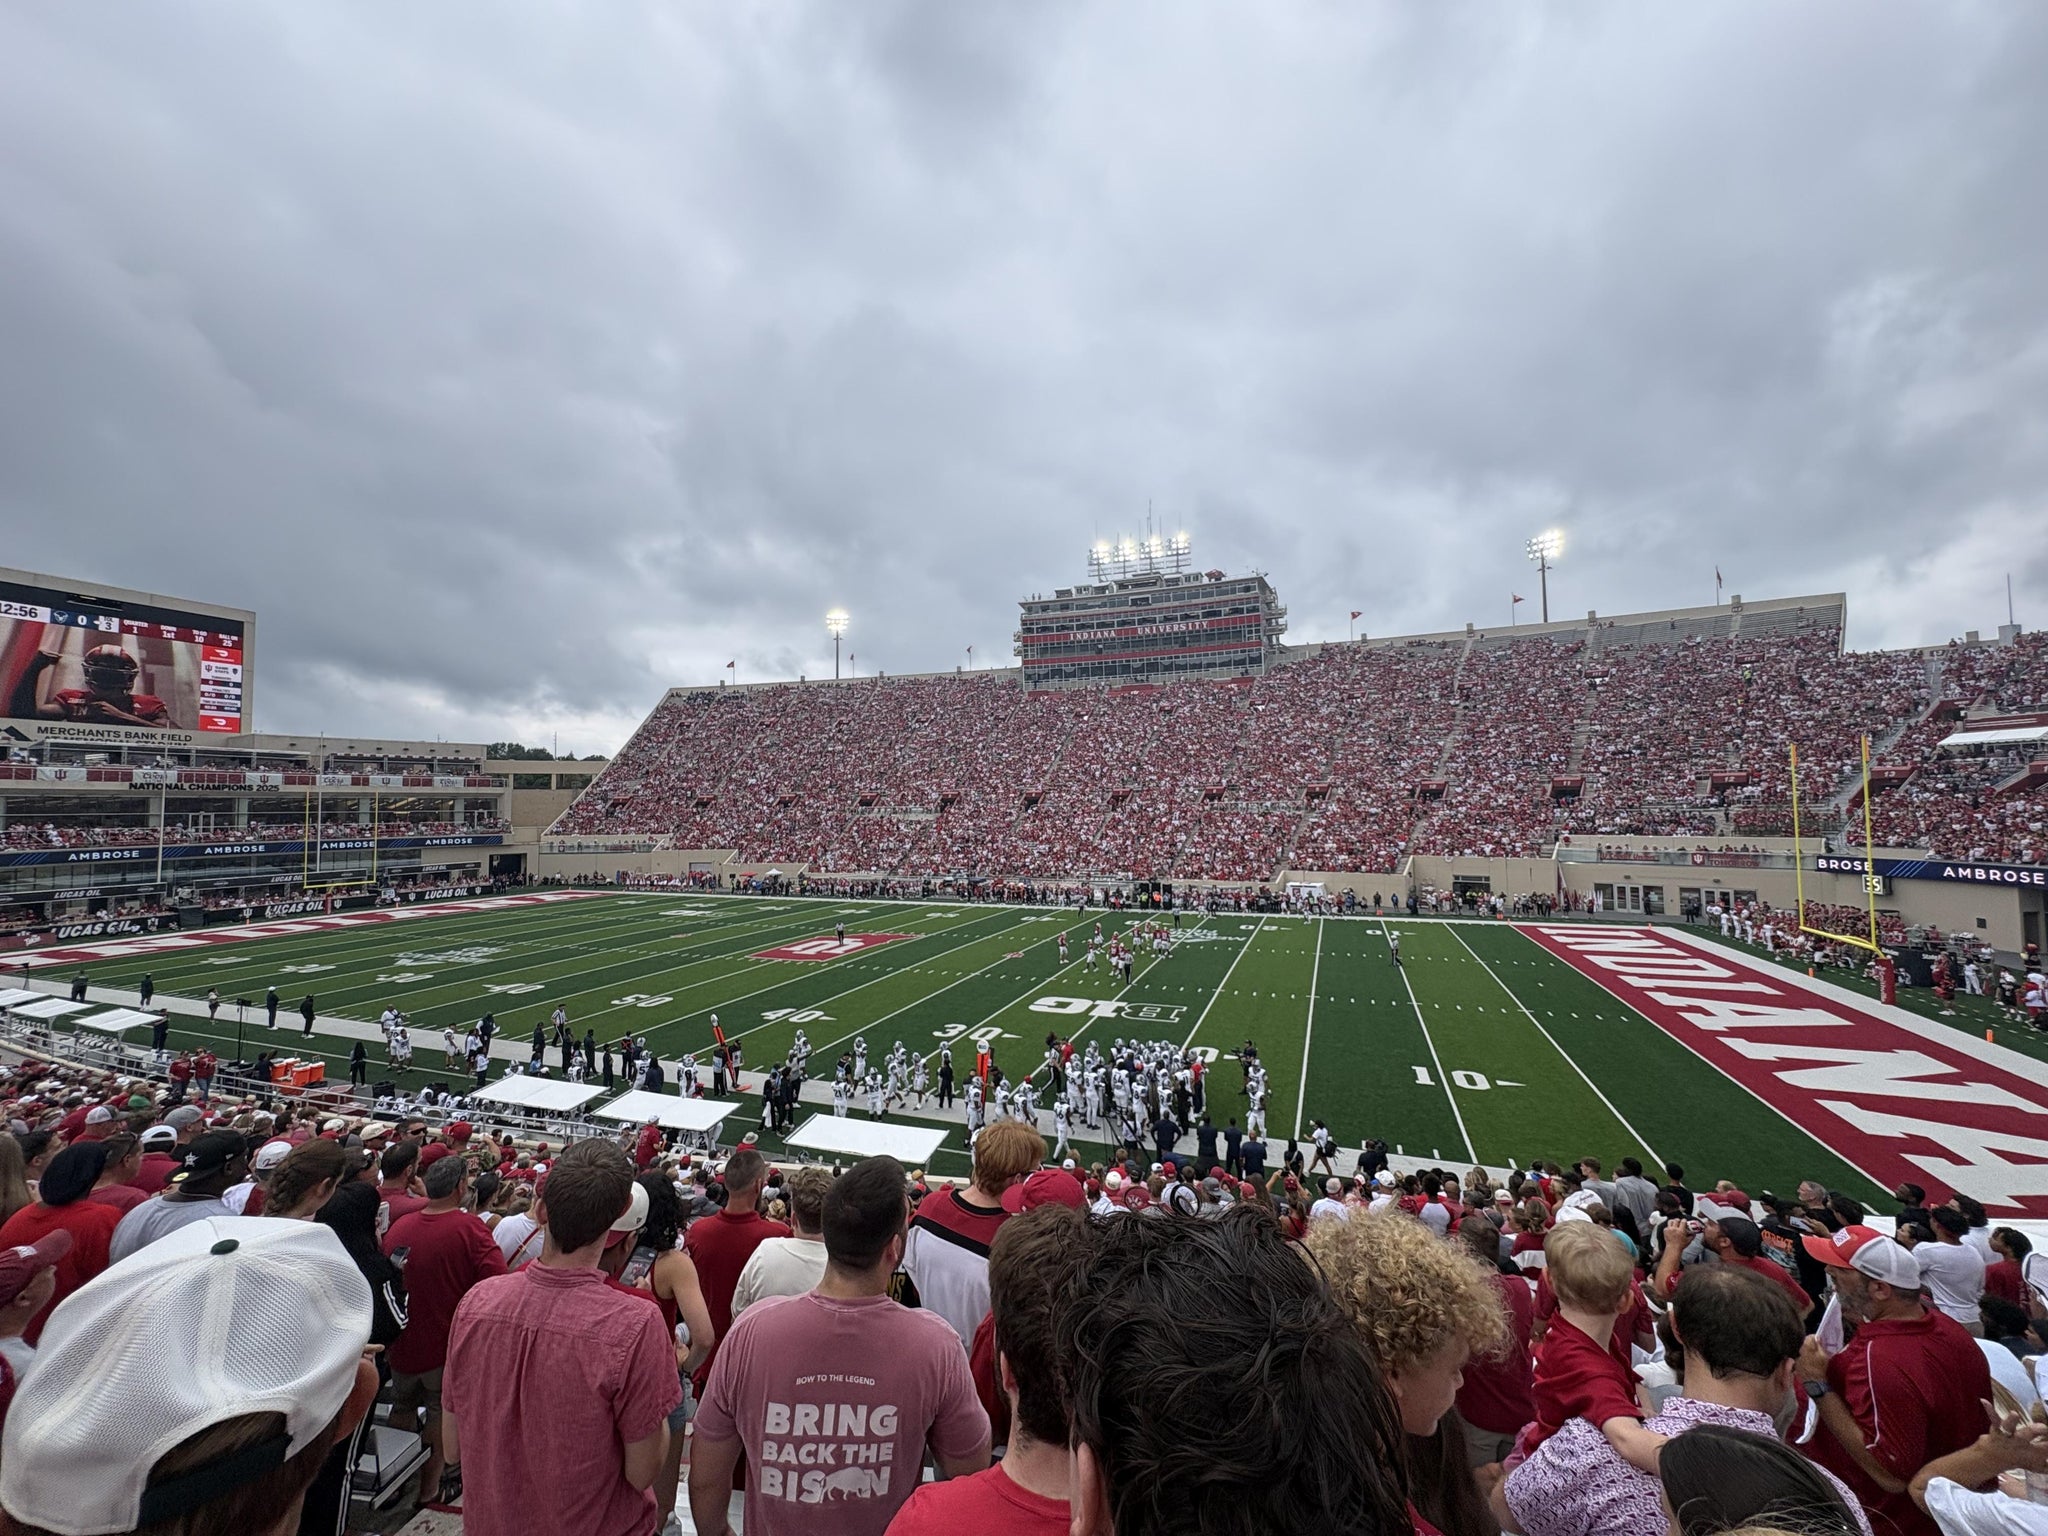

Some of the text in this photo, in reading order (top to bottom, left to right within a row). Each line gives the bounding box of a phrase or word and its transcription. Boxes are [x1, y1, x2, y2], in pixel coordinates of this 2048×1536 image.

[105, 622, 112, 630] 3
[132, 626, 138, 634] 1
[1070, 621, 1208, 640] INDIANA UNIVERSITY
[162, 631, 175, 639] 1st
[37, 726, 192, 742] MERCHANTS BANK FIELD
[129, 783, 186, 791] NATIONAL
[188, 783, 253, 791] CHAMPIONS
[321, 840, 375, 849] AMBROSE
[425, 838, 473, 846] AMBROSE
[68, 850, 140, 862] AMBROSE
[205, 845, 265, 855] AMBROSE
[1943, 866, 2045, 885] AMBROSE
[54, 889, 101, 899] LUCAS OIL
[424, 889, 452, 900] LUCAS
[453, 888, 468, 897] OIL
[306, 900, 324, 912] OIL
[611, 994, 673, 1007] 50
[760, 1008, 825, 1023] 40
[932, 1023, 1003, 1041] 30
[1536, 927, 2048, 1209] INDIANA
[1411, 1065, 1491, 1091] 10
[817, 1374, 827, 1382] TO
[829, 1374, 843, 1382] THE
[845, 1374, 875, 1386] LEGEND
[765, 1402, 898, 1437] BRING
[762, 1440, 894, 1465] BACK THE
